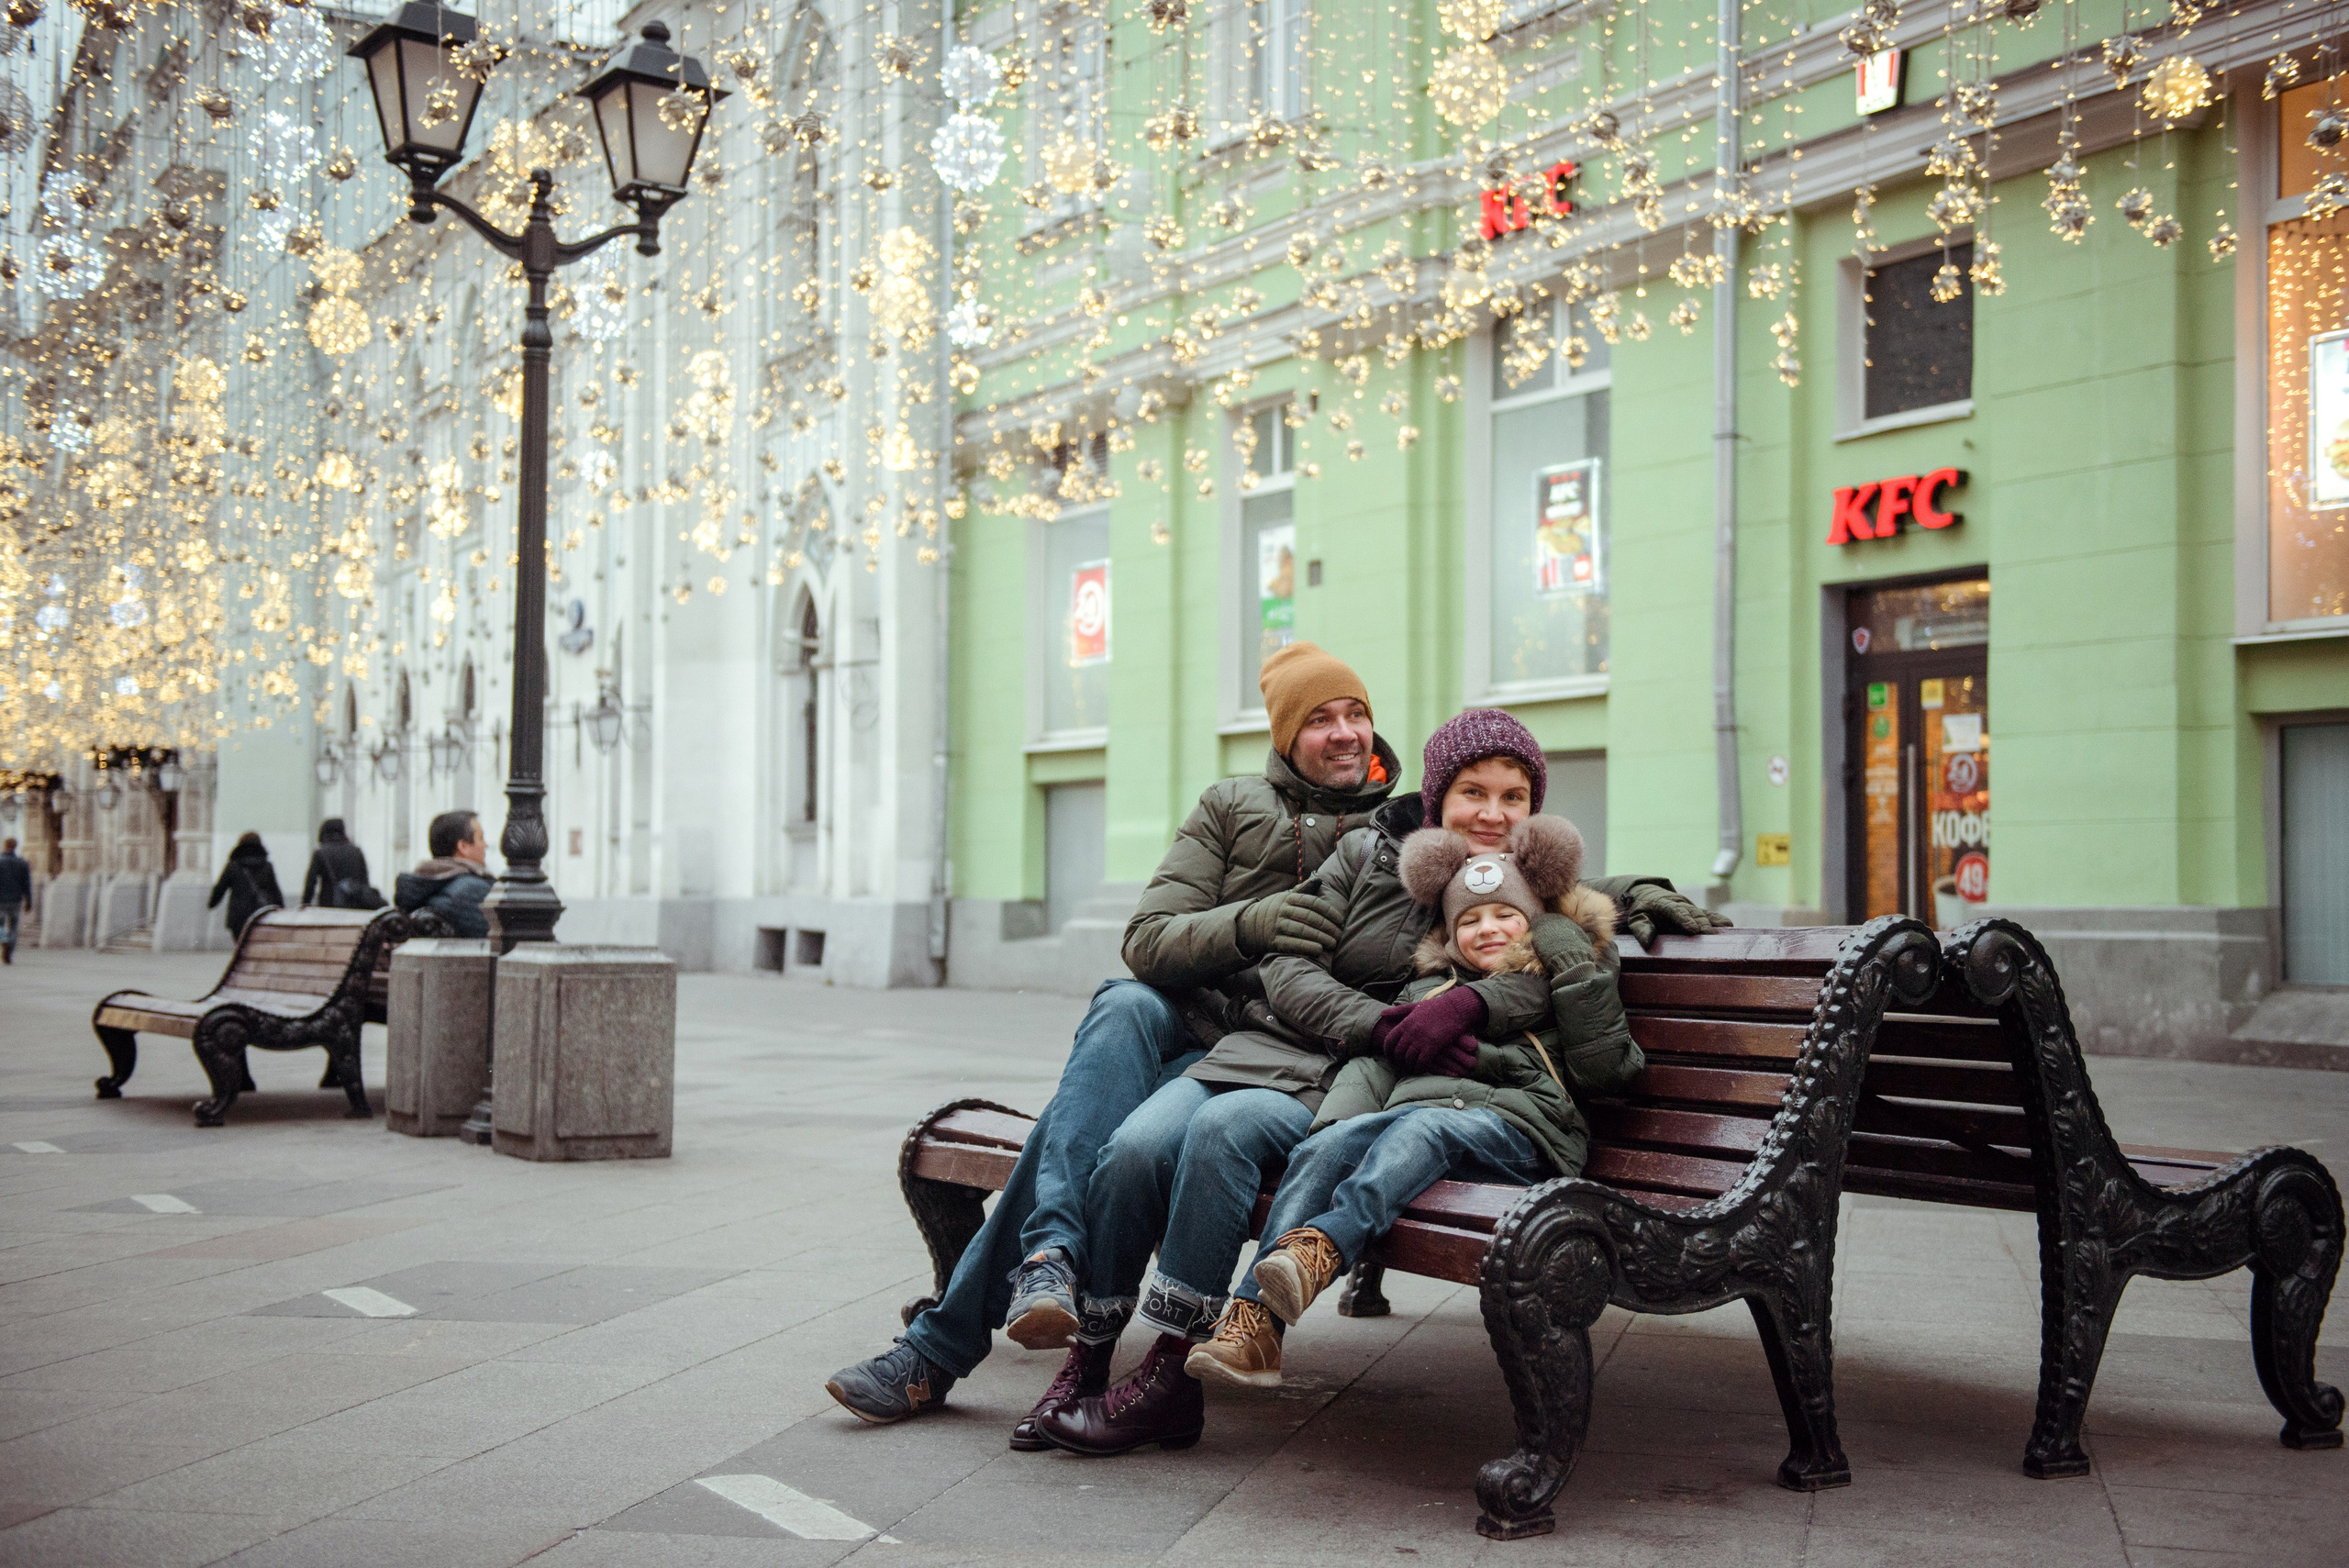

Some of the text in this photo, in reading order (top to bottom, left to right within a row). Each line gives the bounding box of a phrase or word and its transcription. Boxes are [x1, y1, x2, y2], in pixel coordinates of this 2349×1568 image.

[1826, 466, 1960, 546] KFC
[1960, 862, 1984, 895] 49
[905, 1377, 931, 1411] N
